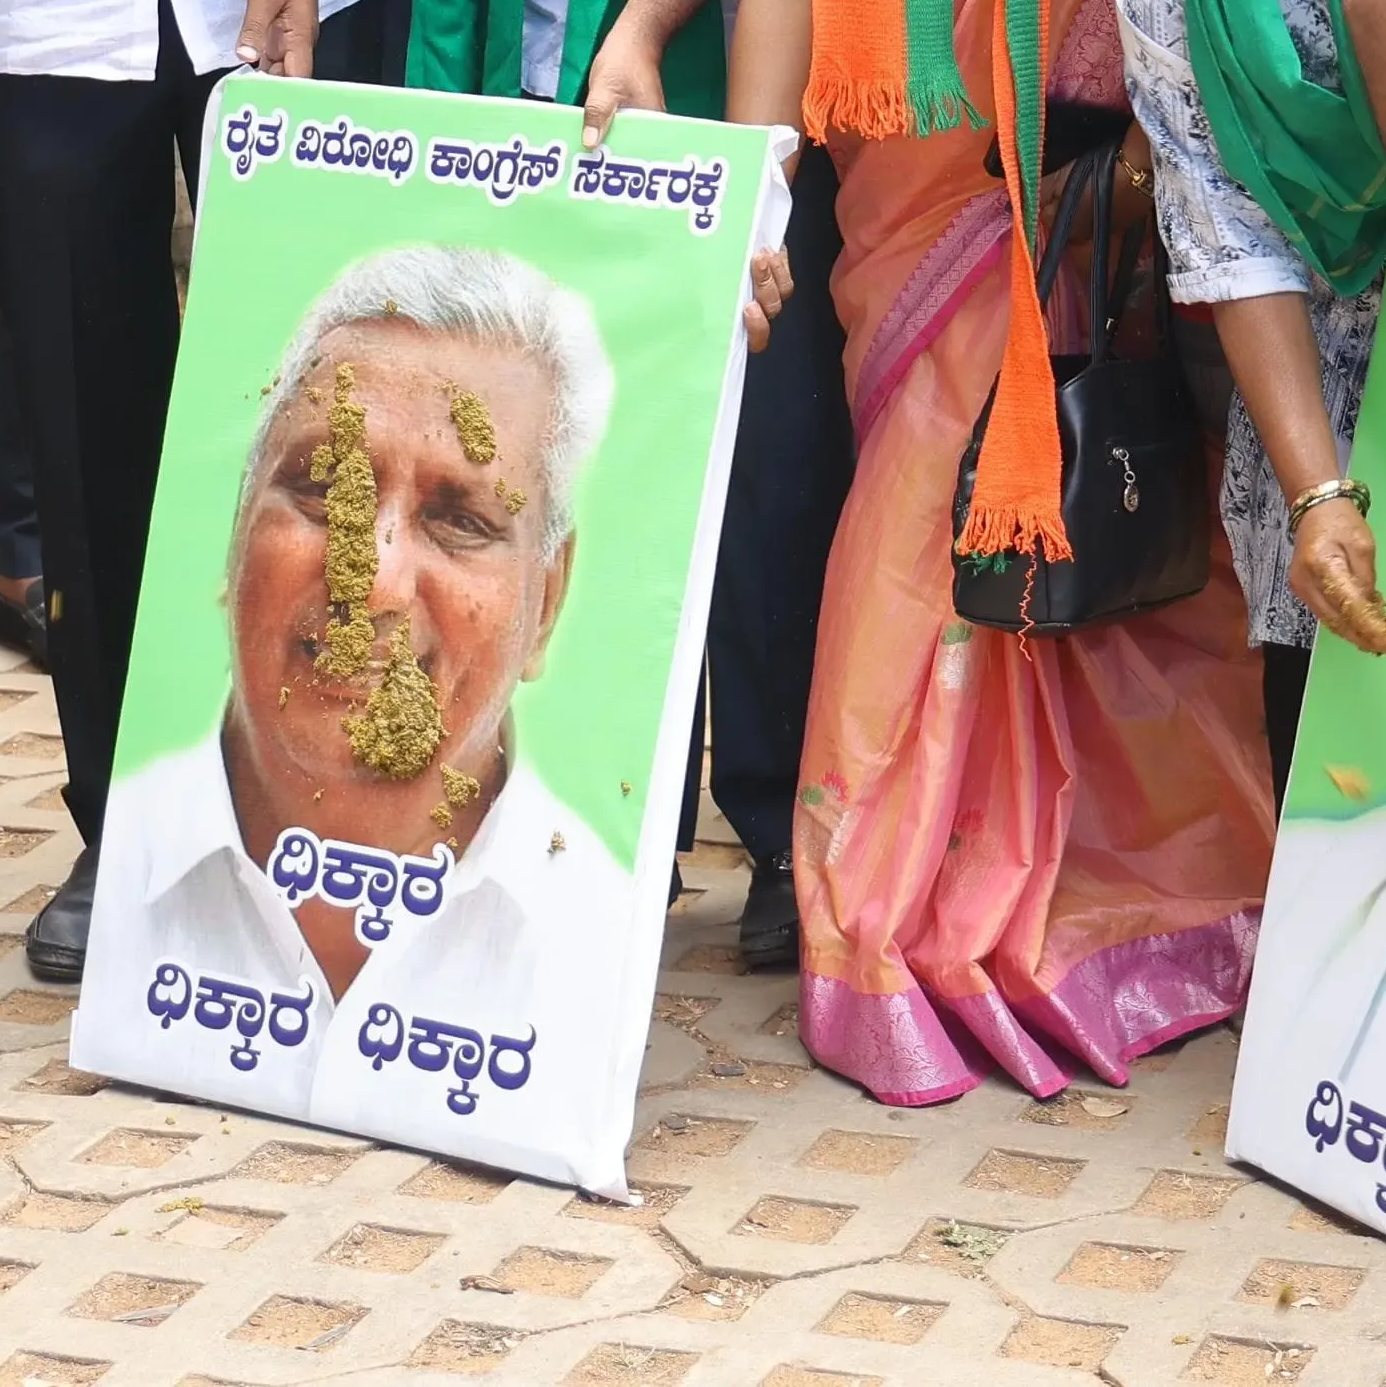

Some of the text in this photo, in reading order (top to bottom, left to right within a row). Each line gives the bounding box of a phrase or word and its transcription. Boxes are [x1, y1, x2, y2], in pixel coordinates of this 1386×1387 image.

[226, 110, 722, 230] ರೈತ ವಿರೋಧಿ ಕಾಂಗ್ರೆಸ್ ಸರ್ಕಾರಕ್ಕೆ
[273, 834, 448, 941] ಧಿಕ್ಕಾರ
[147, 963, 536, 1115] ಧಿಕ್ಕಾರ ಧಿಕ್ಕಾರ
